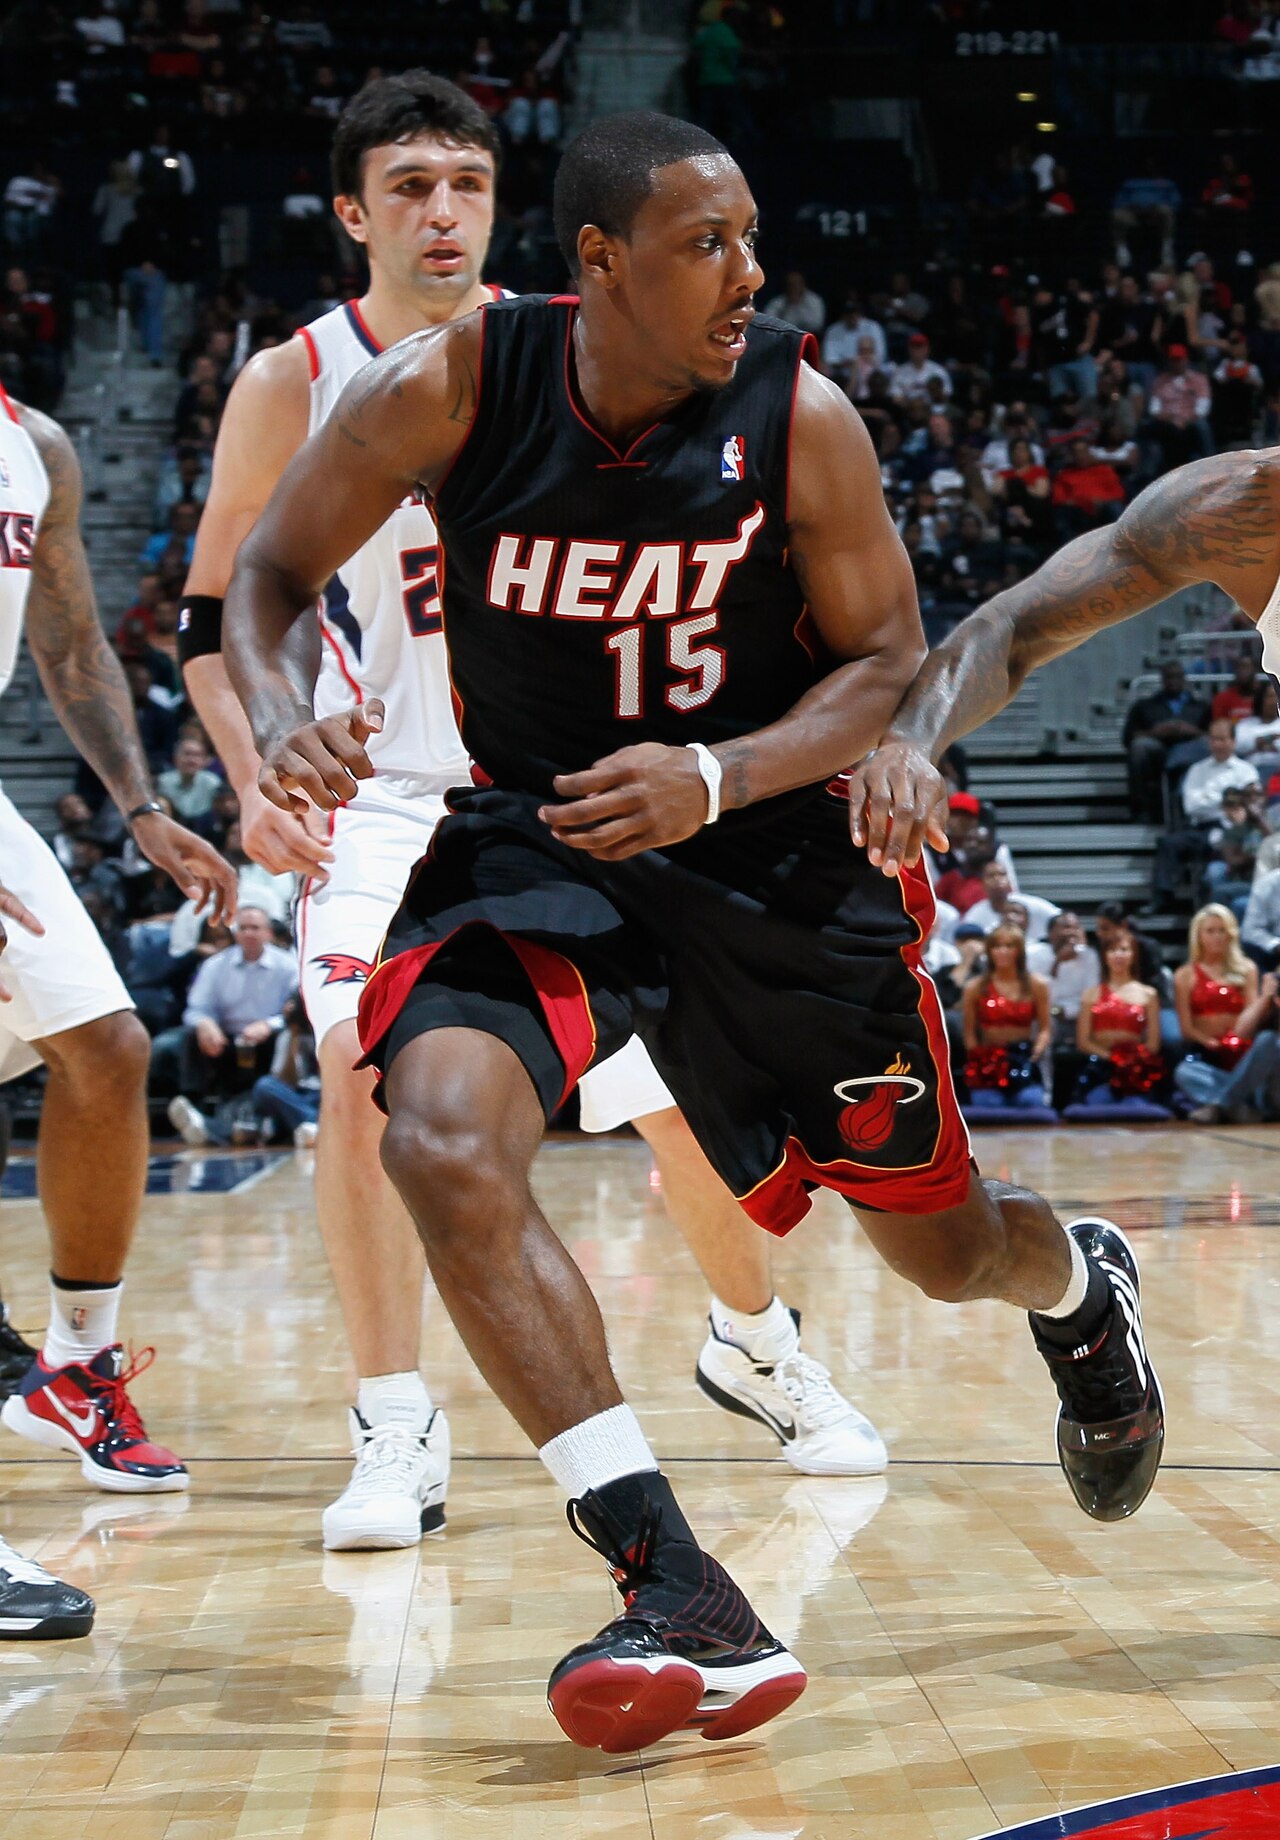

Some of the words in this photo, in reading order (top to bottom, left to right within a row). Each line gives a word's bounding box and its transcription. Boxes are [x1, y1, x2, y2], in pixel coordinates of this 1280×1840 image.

[819, 210, 867, 236] 121
[486, 500, 766, 622] HEAT
[604, 609, 726, 720] 15
